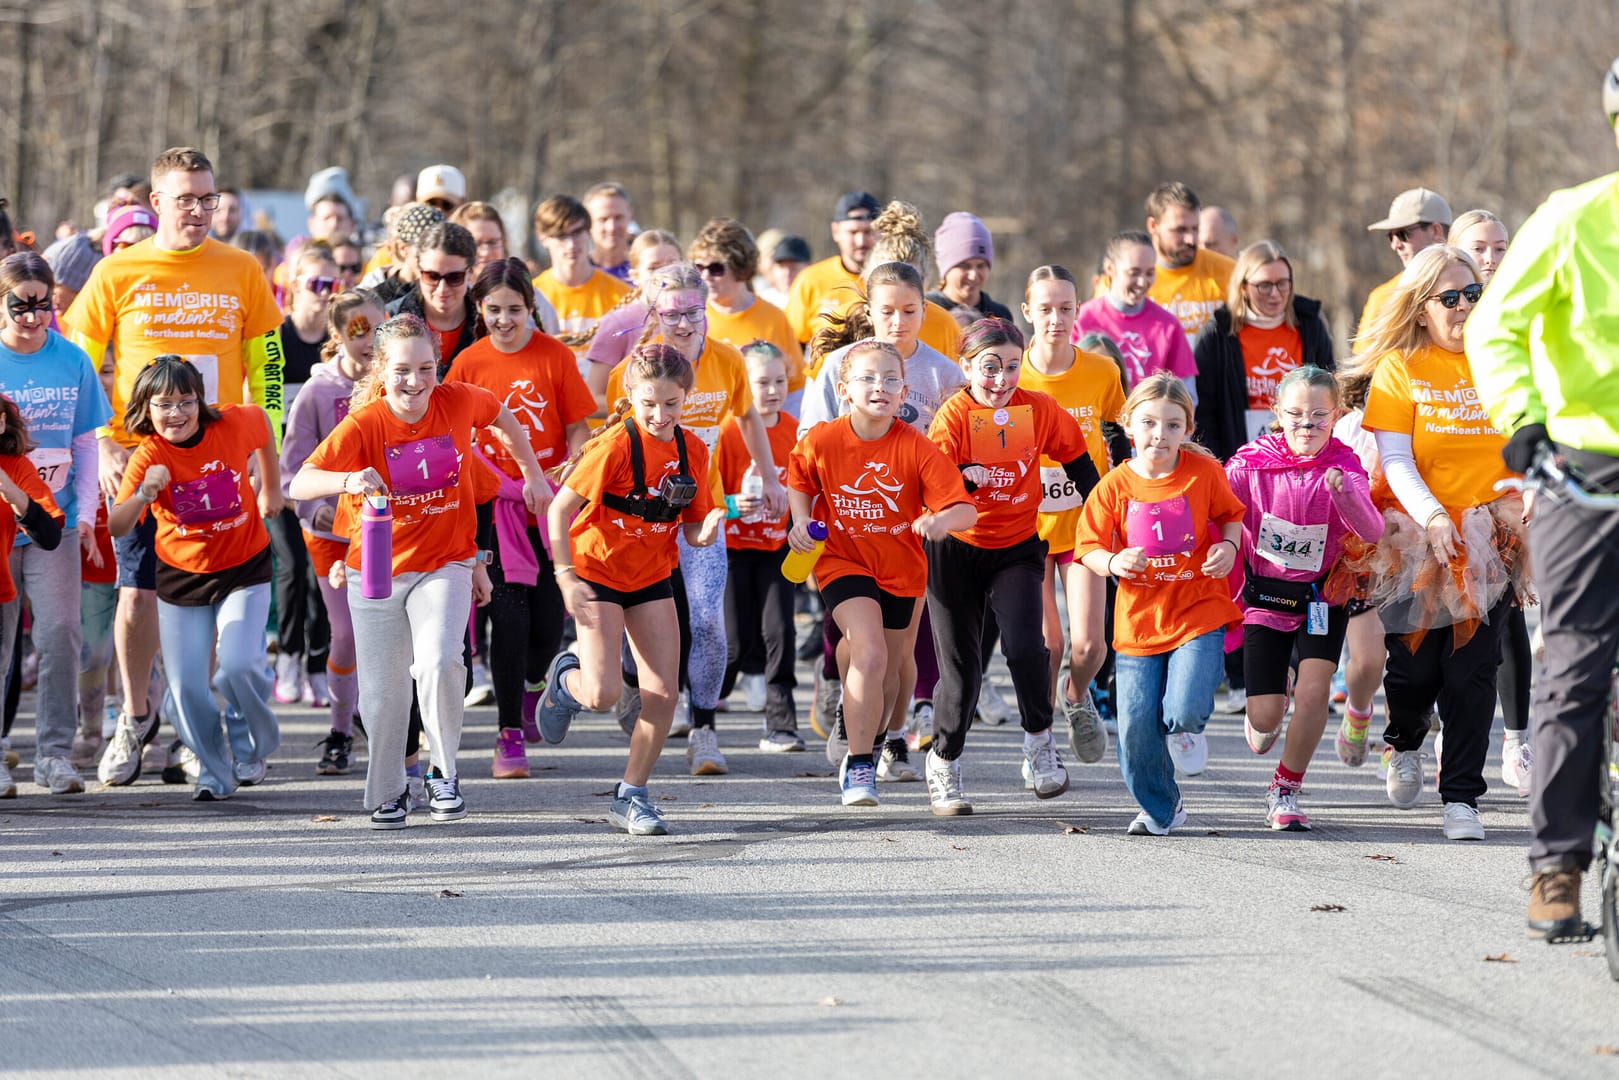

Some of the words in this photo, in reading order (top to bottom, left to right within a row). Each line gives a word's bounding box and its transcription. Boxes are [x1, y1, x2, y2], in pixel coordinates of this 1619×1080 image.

[133, 291, 240, 310] MEMORIES
[143, 328, 194, 338] Northeast
[196, 330, 229, 340] Indiana
[265, 341, 281, 362] CITY
[2, 387, 79, 404] EMORIES
[684, 390, 727, 405] MORIES
[1413, 388, 1480, 406] MEMO
[1066, 405, 1093, 417] RIES
[1425, 423, 1481, 434] Northeast
[998, 429, 1006, 449] 1
[417, 458, 429, 480] 1
[200, 493, 212, 511] 1
[409, 489, 444, 506] run
[849, 508, 885, 520] run
[1151, 520, 1163, 541] 1
[1271, 534, 1312, 556] 344
[1260, 594, 1297, 608] saucony
